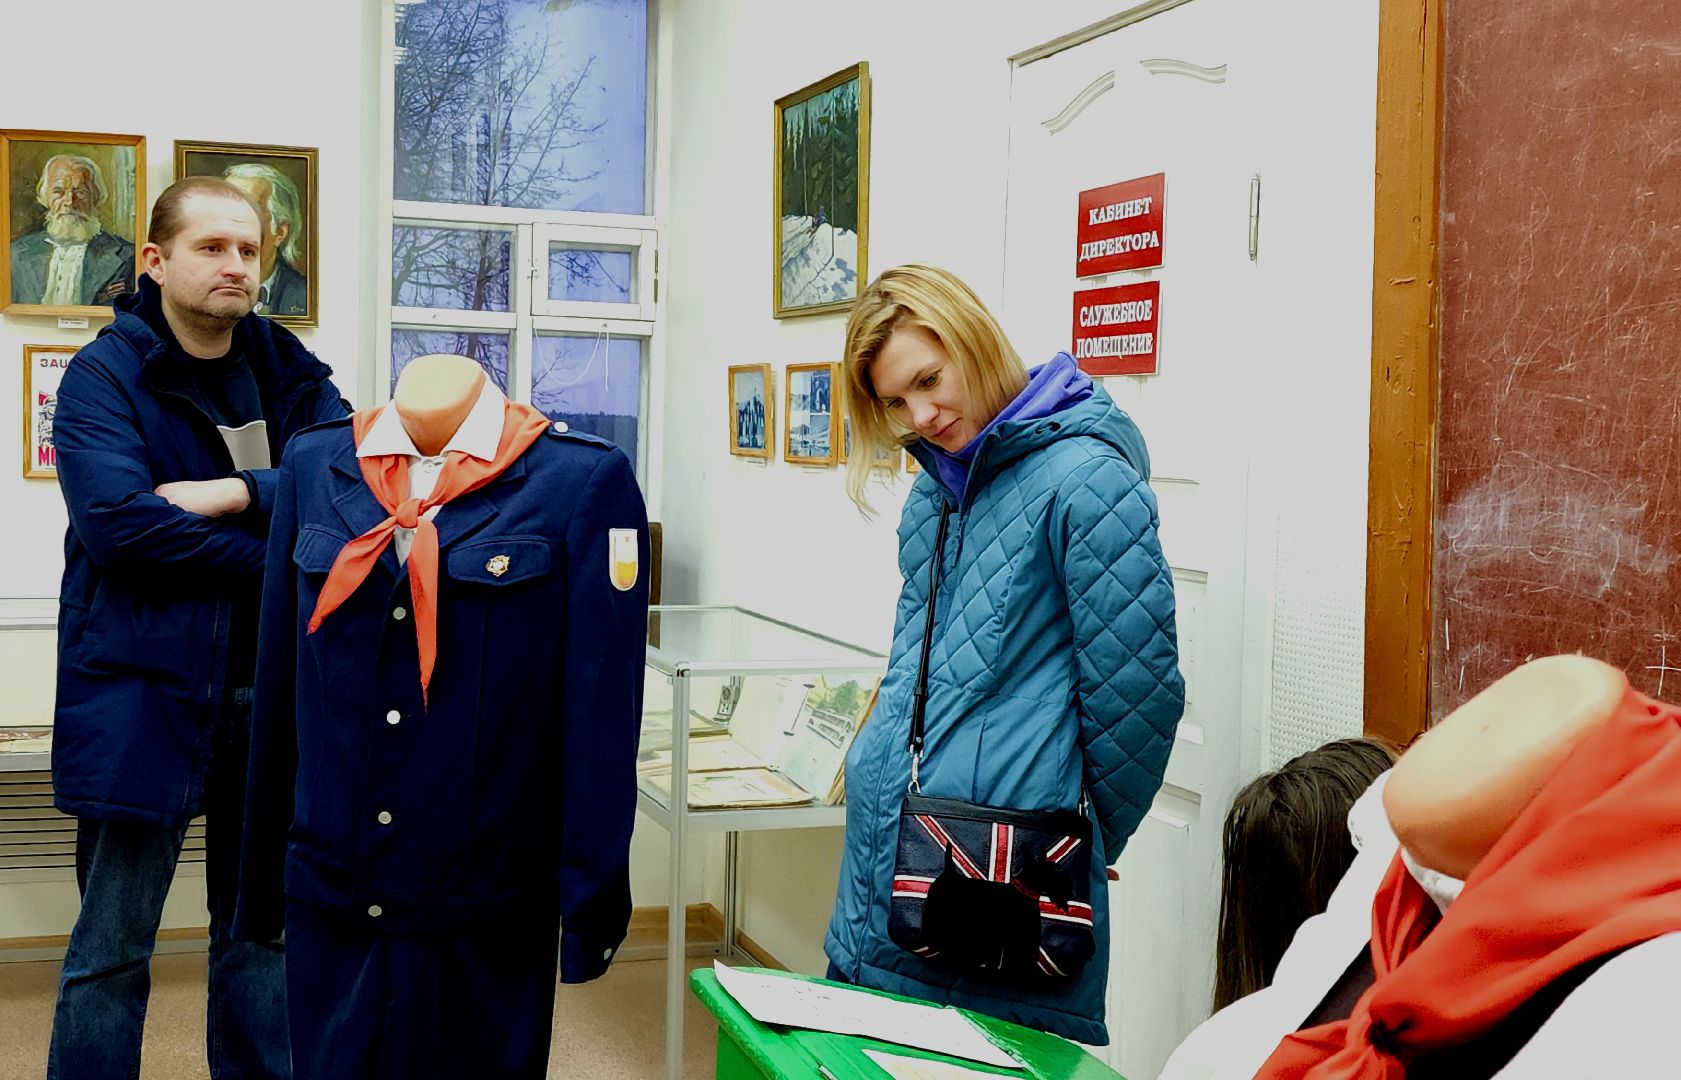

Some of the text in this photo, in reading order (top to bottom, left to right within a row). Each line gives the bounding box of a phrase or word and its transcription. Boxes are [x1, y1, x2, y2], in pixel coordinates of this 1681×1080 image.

[1089, 197, 1152, 225] КАБИНЕТ
[1080, 230, 1159, 262] ДИРЕКТОРА
[1080, 300, 1152, 327] СЛУЖЕБНОЕ
[1075, 332, 1153, 359] ПОМЕЩЕНИЕ
